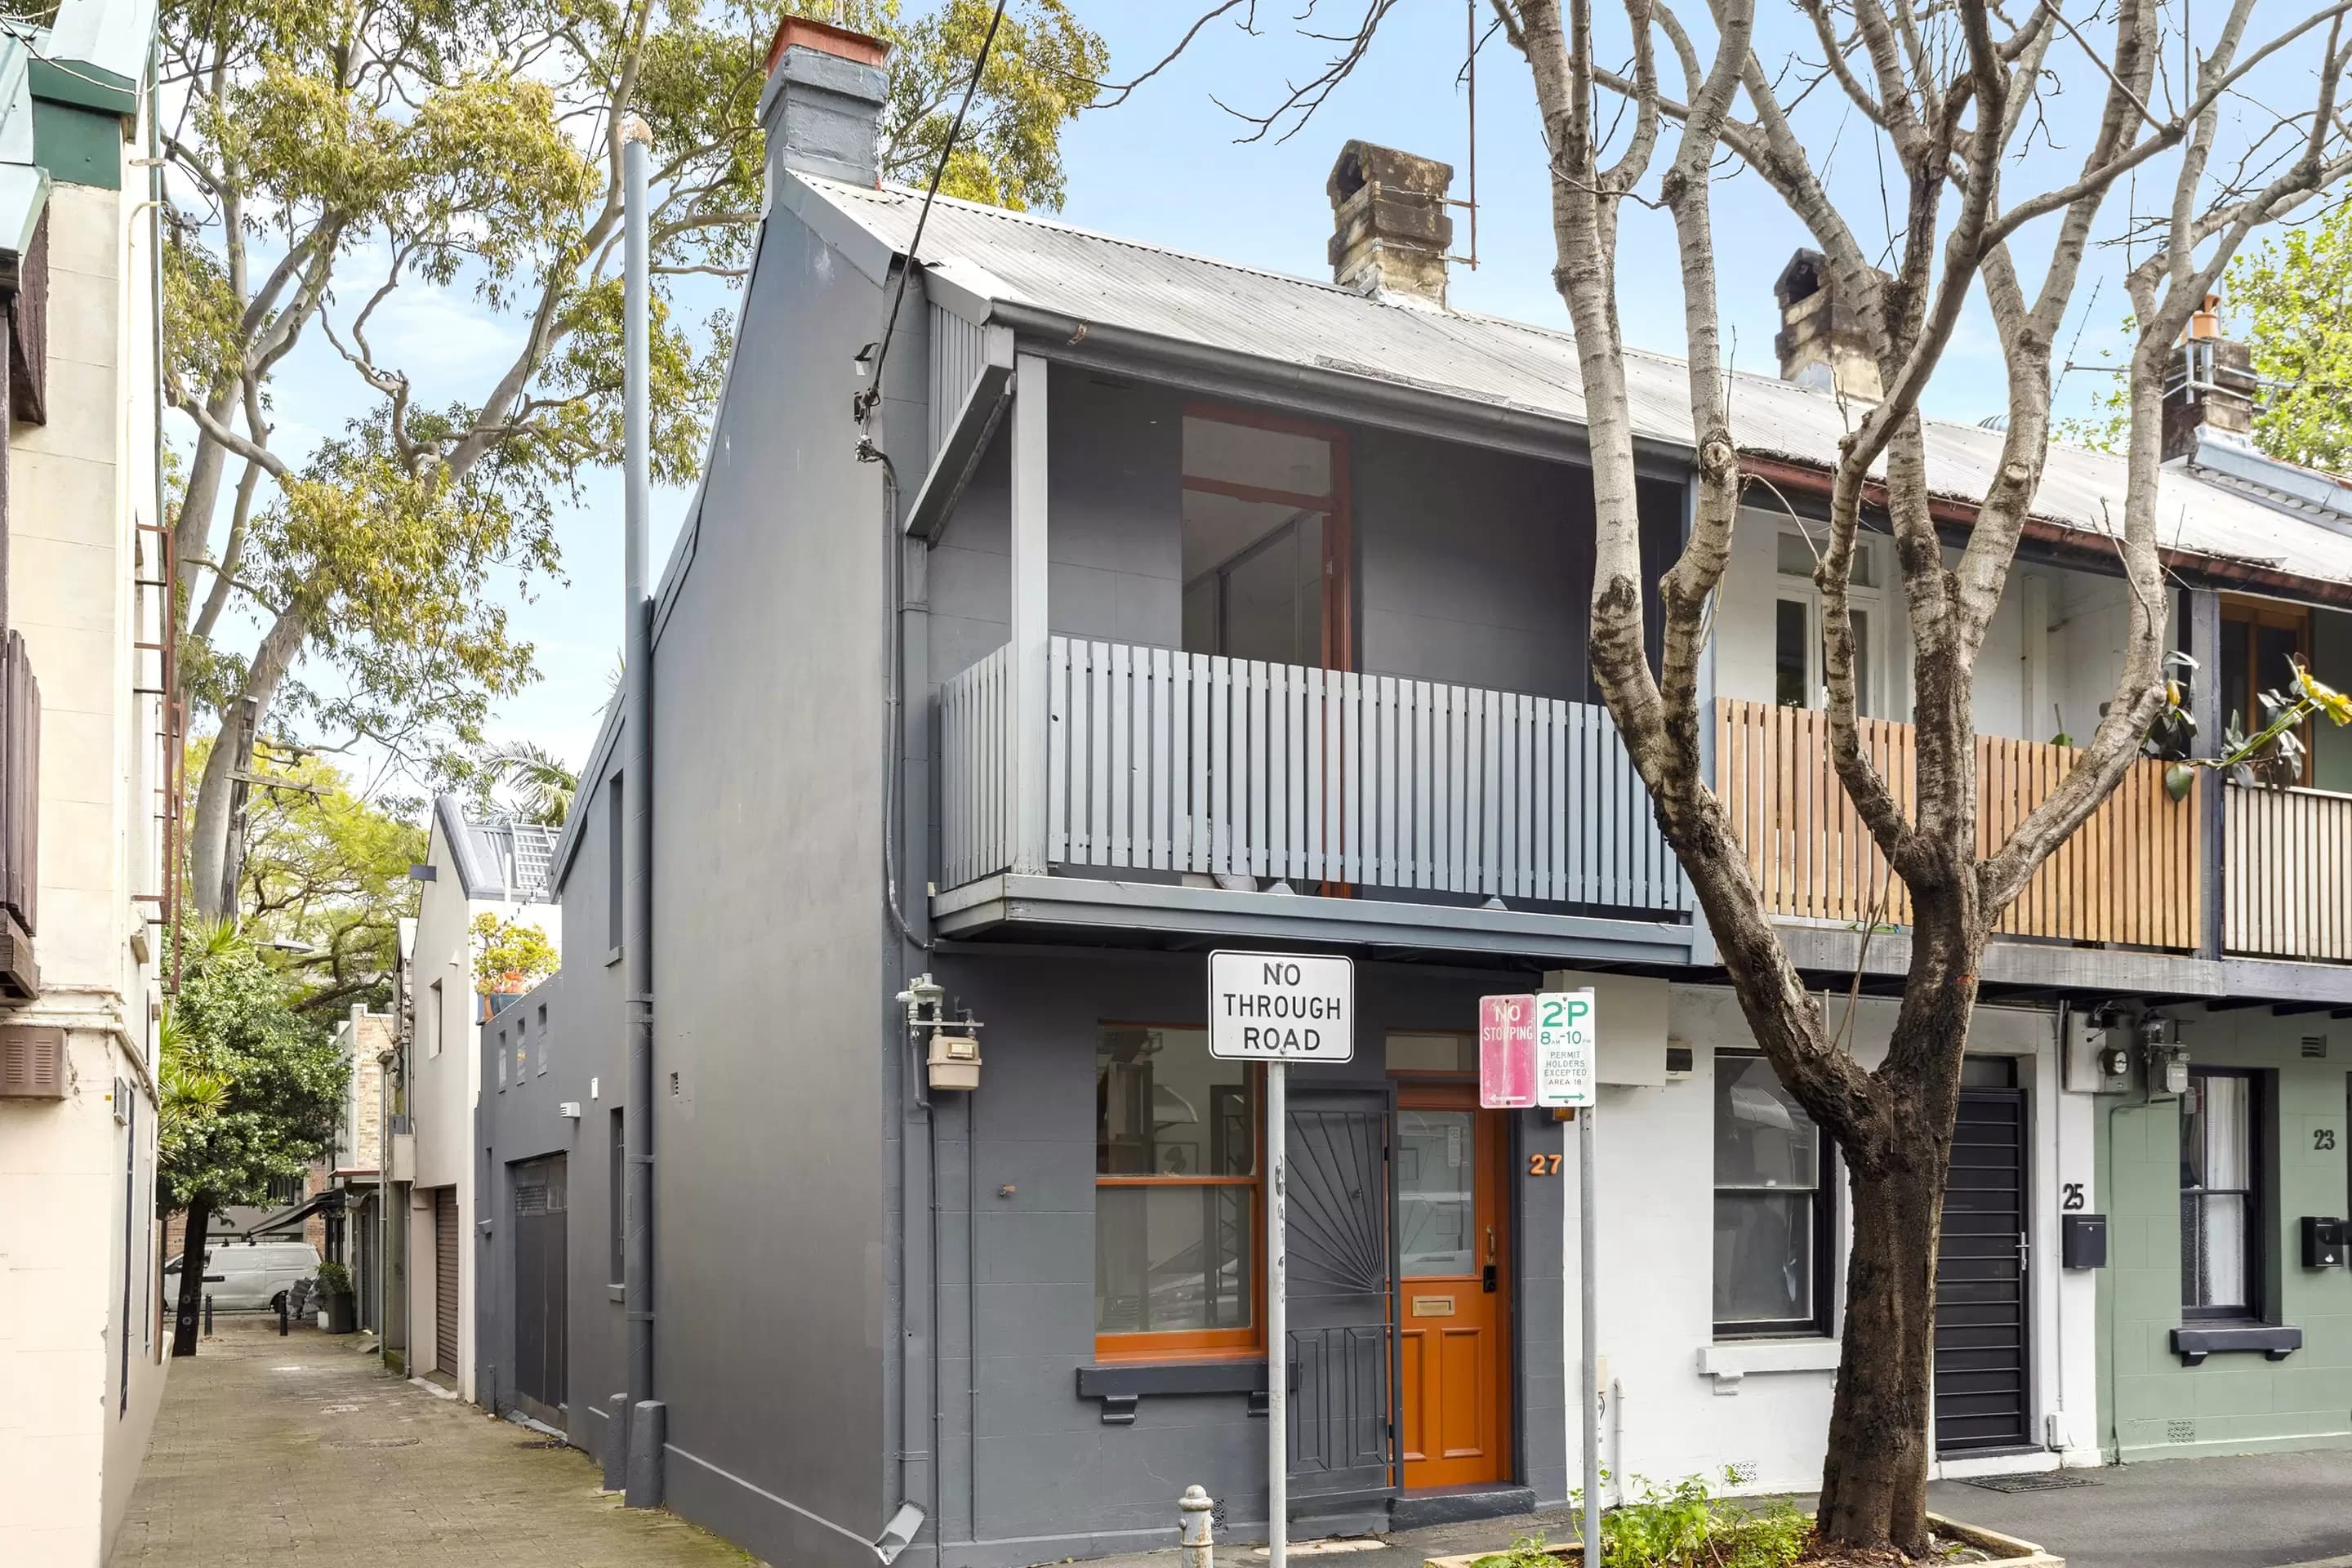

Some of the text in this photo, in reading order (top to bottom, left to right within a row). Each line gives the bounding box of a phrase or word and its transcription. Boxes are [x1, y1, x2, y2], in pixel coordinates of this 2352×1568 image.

[1263, 962, 1301, 986] NO
[1223, 993, 1340, 1020] THROUGH
[1495, 1004, 1521, 1022] NO
[1542, 1000, 1588, 1027] 2P
[1244, 1027, 1321, 1051] ROAD
[1546, 1059, 1585, 1067] HOLDERS
[1550, 1051, 1580, 1059] PERMIT
[1544, 1068, 1587, 1077] EXCEPTED
[2314, 1129, 2335, 1150] 23
[1530, 1153, 1561, 1175] 27
[2063, 1183, 2084, 1209] 25
